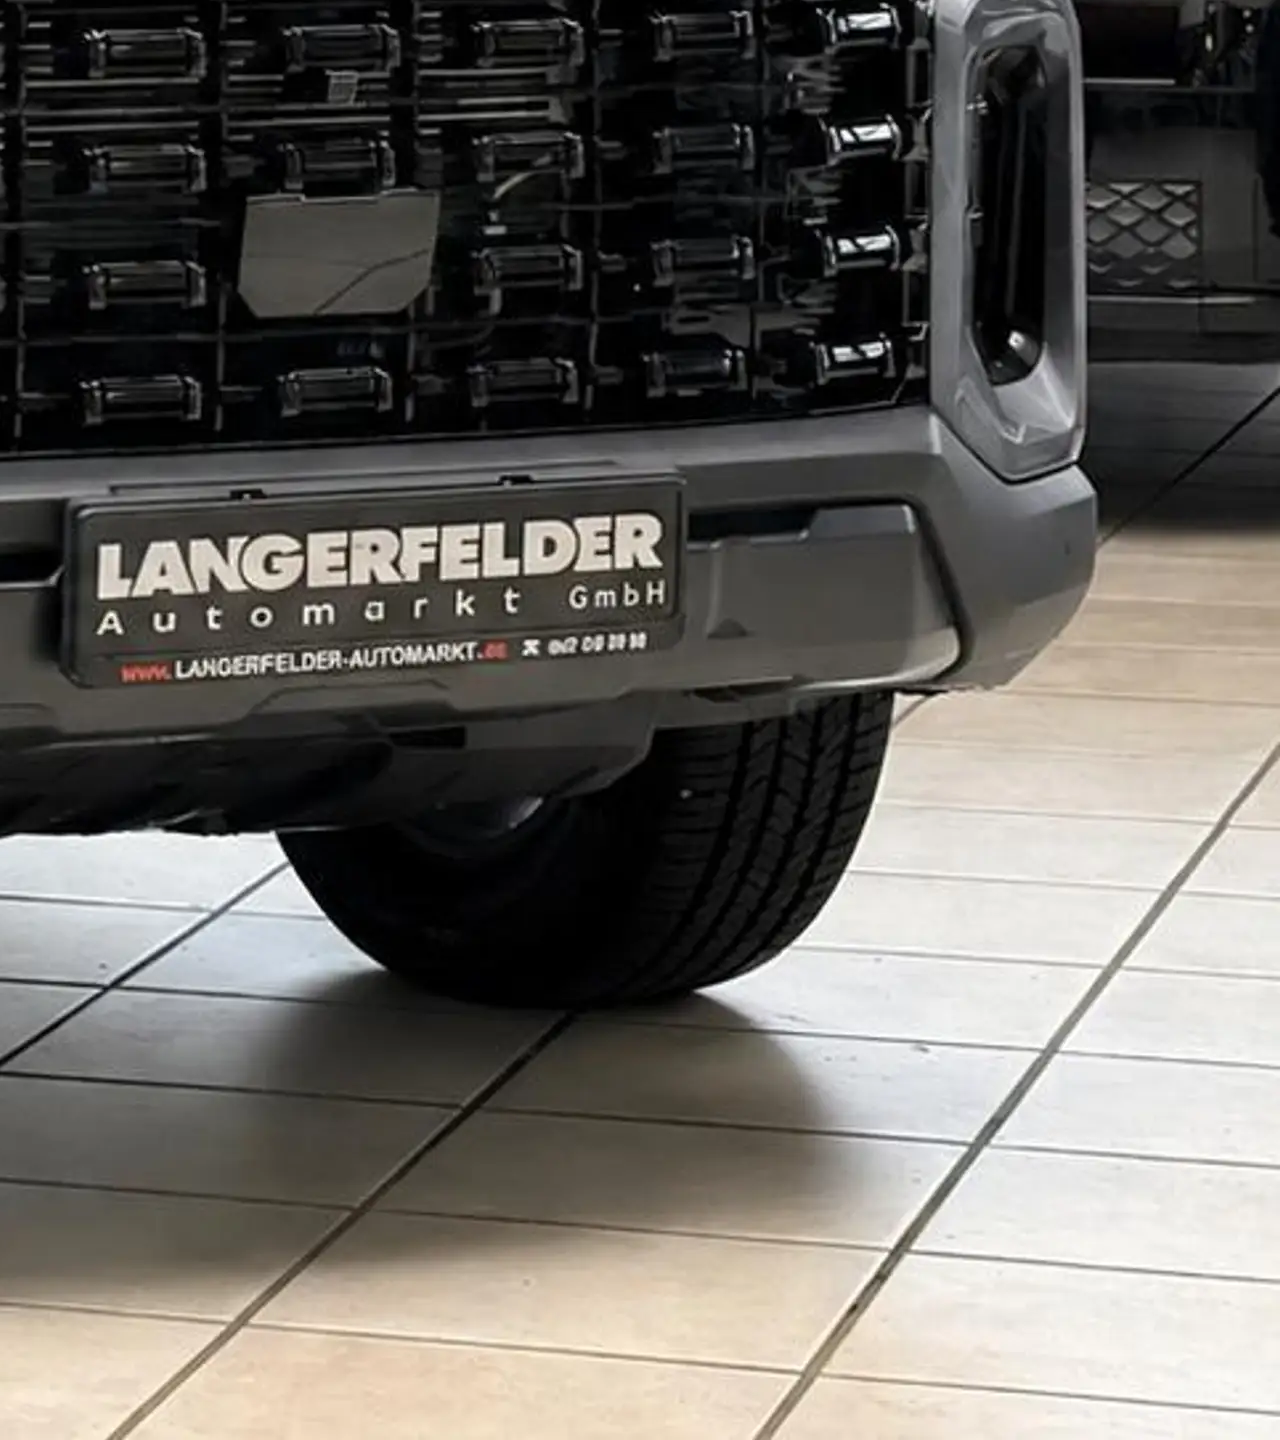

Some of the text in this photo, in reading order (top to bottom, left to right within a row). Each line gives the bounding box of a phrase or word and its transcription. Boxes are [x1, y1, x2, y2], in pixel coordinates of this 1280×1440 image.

[96, 513, 663, 600] LANGERFELDER
[95, 579, 666, 636] Automarkt GmbH
